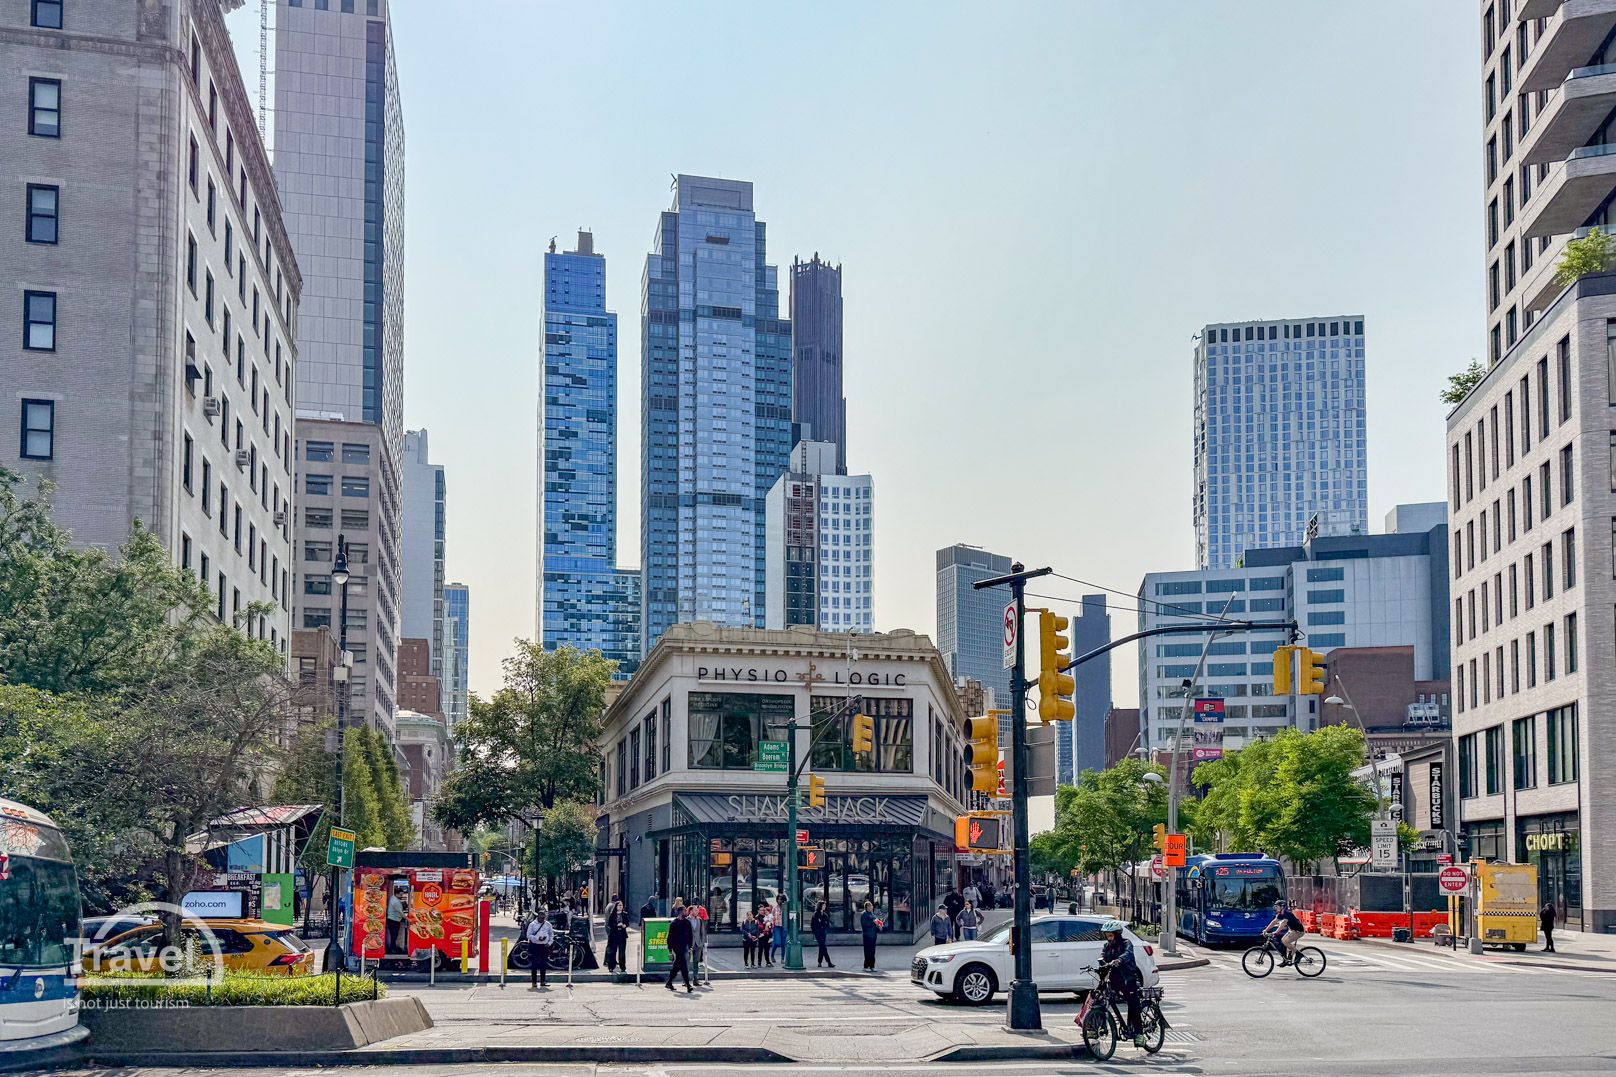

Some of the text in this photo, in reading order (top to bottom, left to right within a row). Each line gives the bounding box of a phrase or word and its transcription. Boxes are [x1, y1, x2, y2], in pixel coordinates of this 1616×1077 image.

[698, 667, 906, 687] PHYSIO LOGIC
[1431, 767, 1441, 825] STARBUCKS
[728, 795, 797, 818] SHAK
[1526, 833, 1565, 851] CHOPT
[1379, 849, 1391, 859] 15
[227, 873, 256, 881] BREAKFAST
[184, 900, 227, 908] zoho.com
